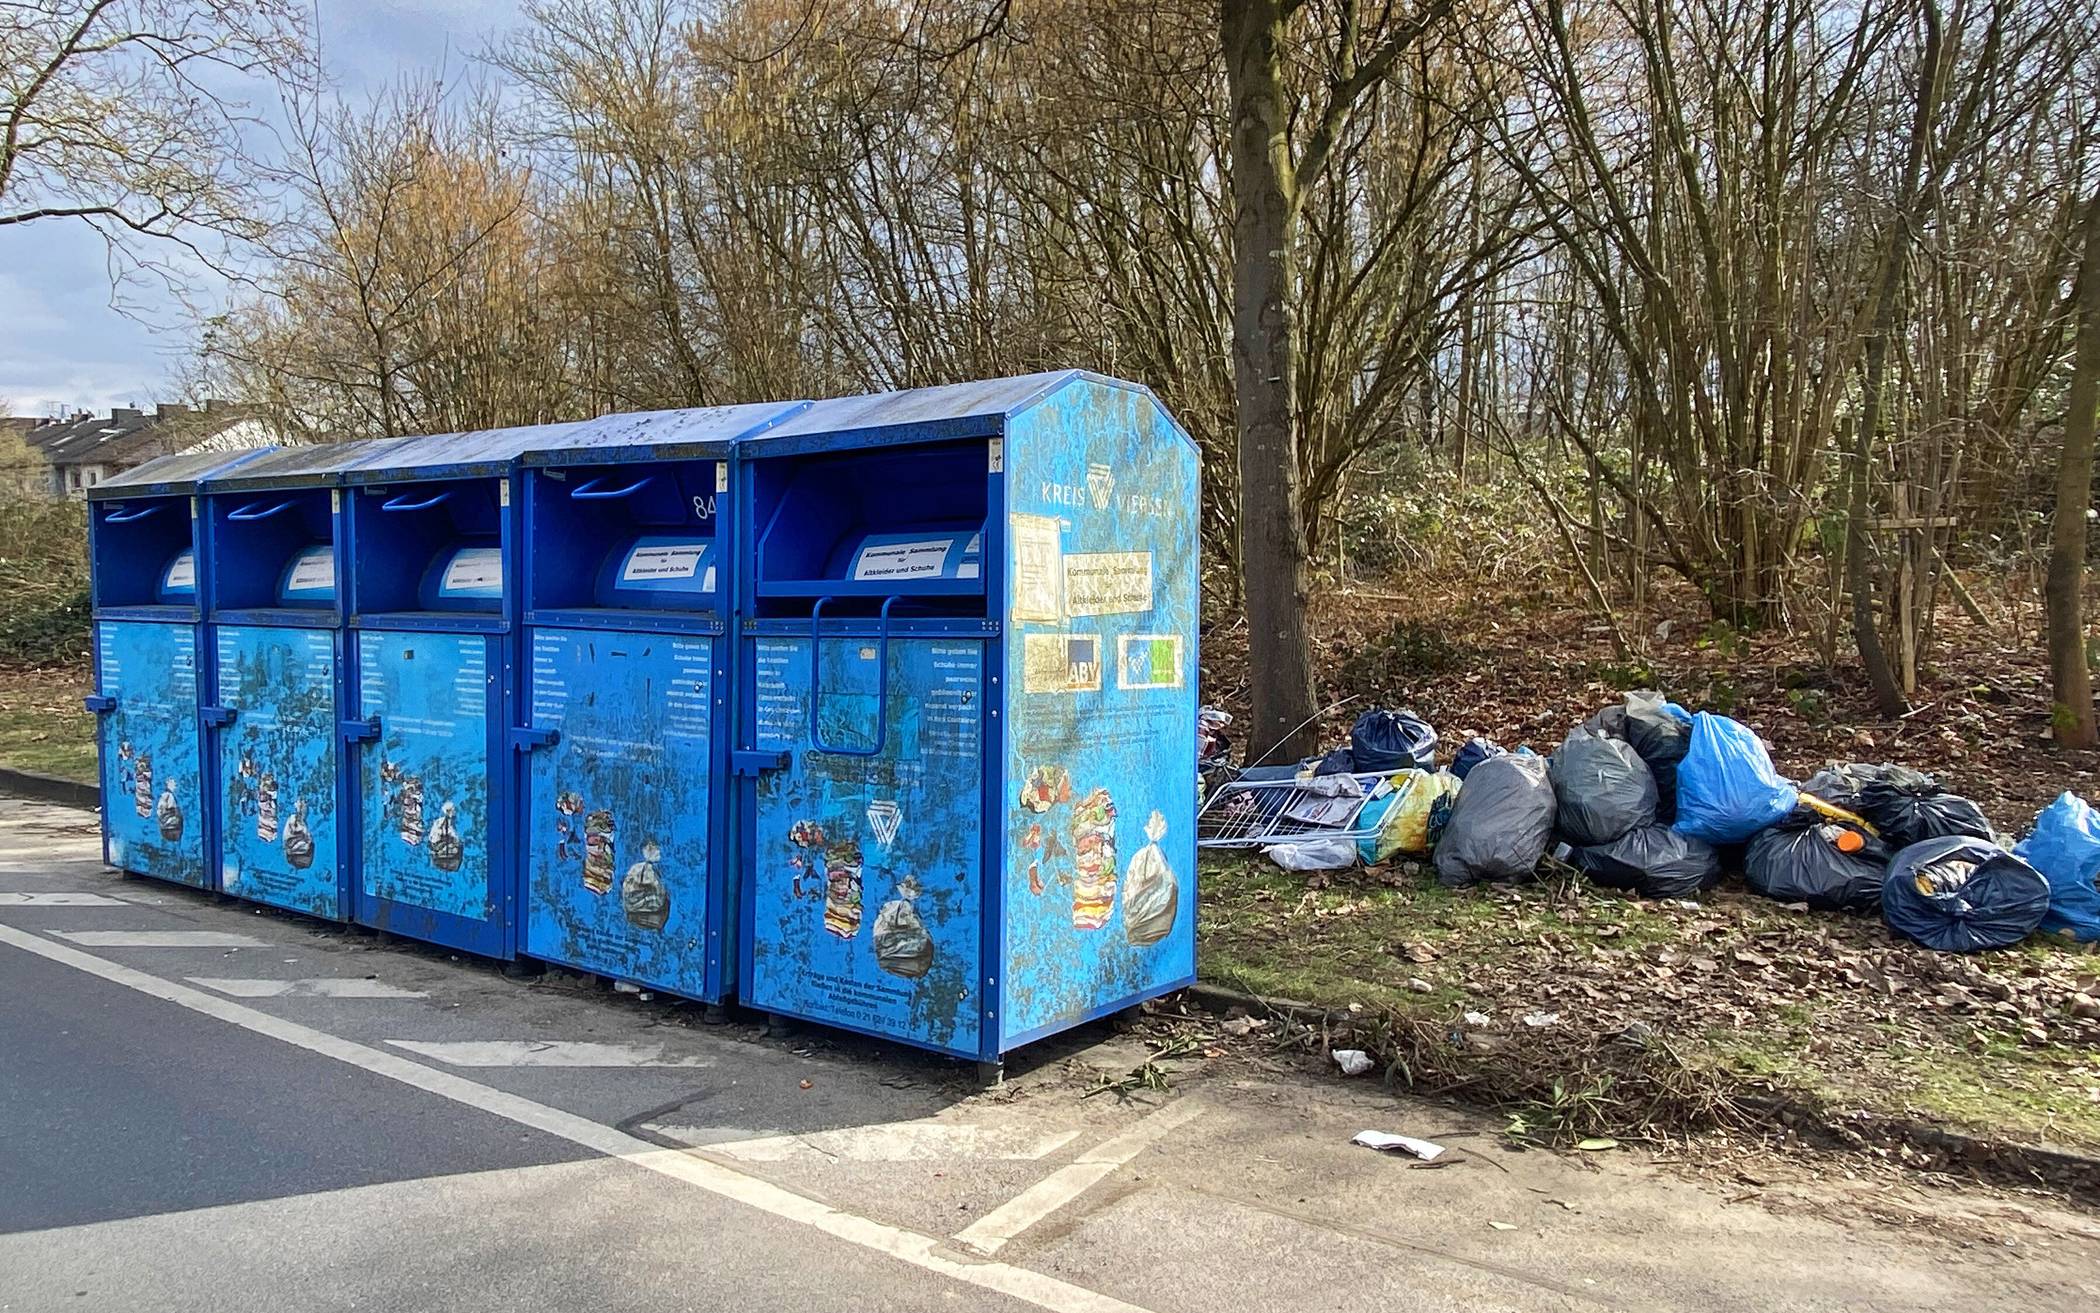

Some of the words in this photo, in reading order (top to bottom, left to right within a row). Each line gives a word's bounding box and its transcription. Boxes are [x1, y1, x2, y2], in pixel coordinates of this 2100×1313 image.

[1042, 481, 1085, 508] KREIS
[866, 550, 906, 558] Kommunale
[863, 568, 894, 576] Altkleider
